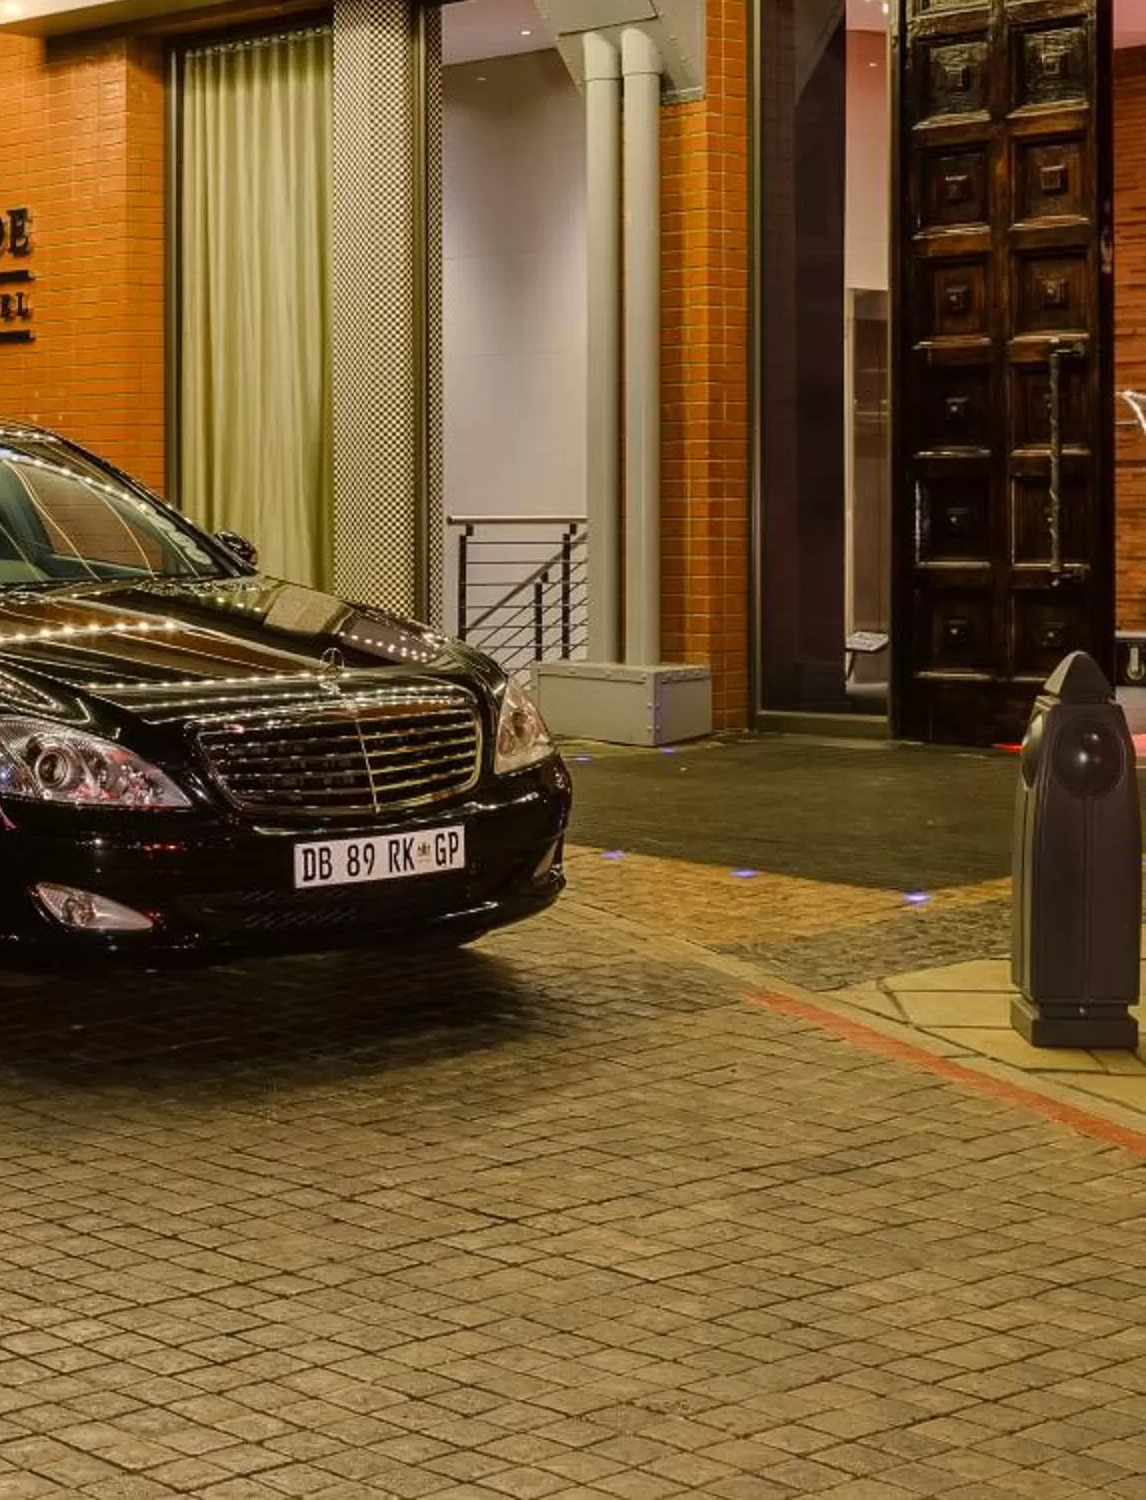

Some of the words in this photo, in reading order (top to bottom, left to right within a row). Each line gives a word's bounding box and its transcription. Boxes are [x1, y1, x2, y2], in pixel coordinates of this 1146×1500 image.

[302, 847, 333, 882] DB
[346, 843, 375, 876] 89
[389, 837, 416, 873] RK
[435, 831, 459, 866] GP
